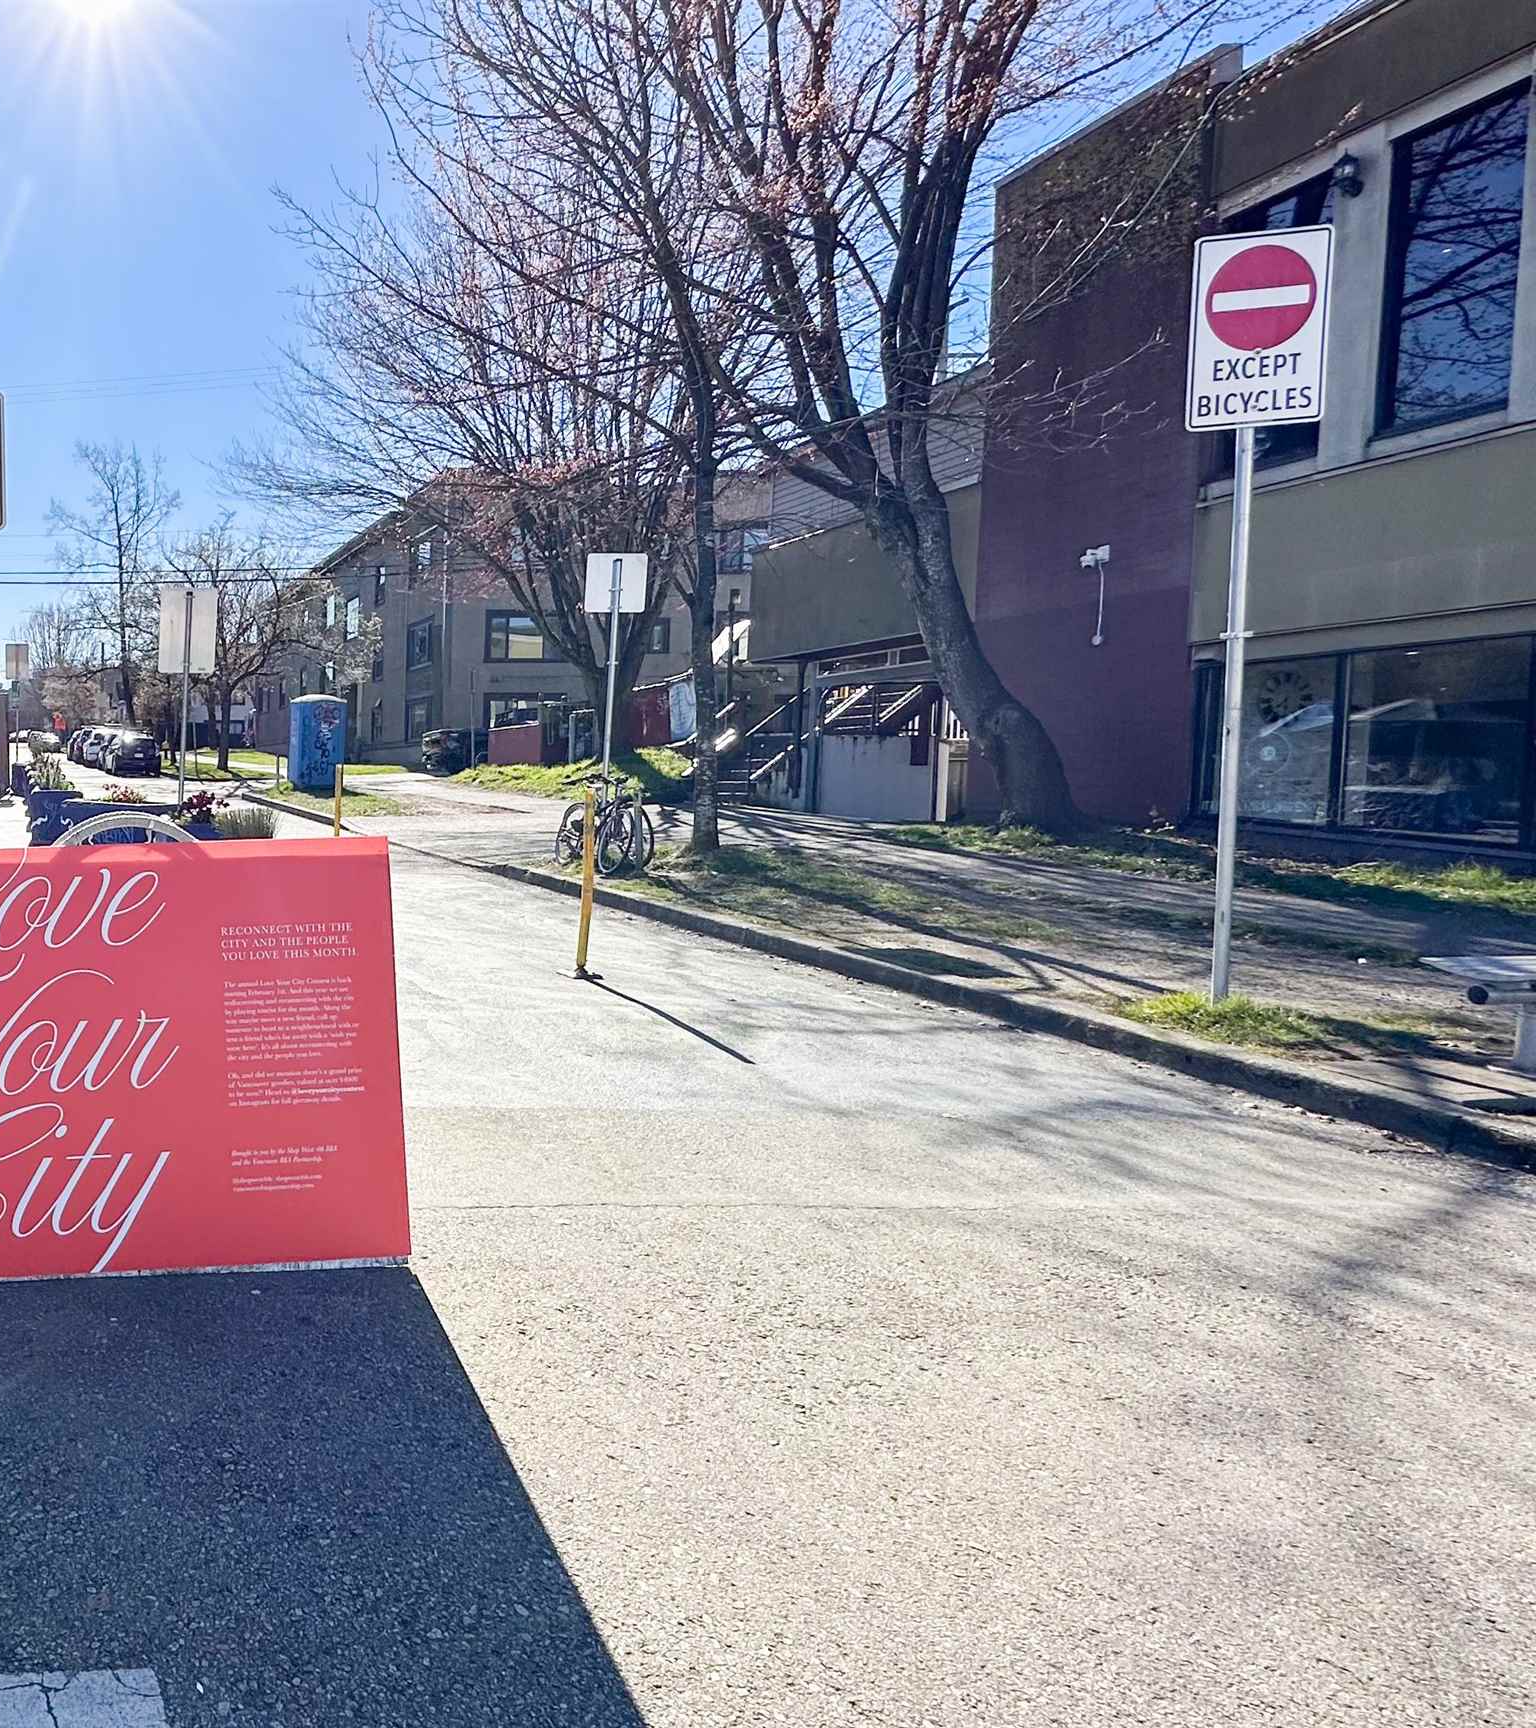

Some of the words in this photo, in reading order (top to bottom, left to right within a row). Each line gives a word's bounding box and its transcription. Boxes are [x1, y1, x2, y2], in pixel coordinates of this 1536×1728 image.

[1213, 353, 1301, 381] EXCEPT
[1197, 386, 1312, 417] BICYCLES
[221, 924, 292, 936] RECONNECT
[295, 922, 326, 933] WITH
[330, 922, 352, 932] THE
[221, 939, 248, 949] CITY
[252, 938, 276, 948] AND
[280, 937, 303, 946] THE
[306, 935, 349, 945] PEOPLE
[222, 951, 245, 961] YOU
[250, 950, 279, 960] LOVE
[284, 949, 310, 959] THIS
